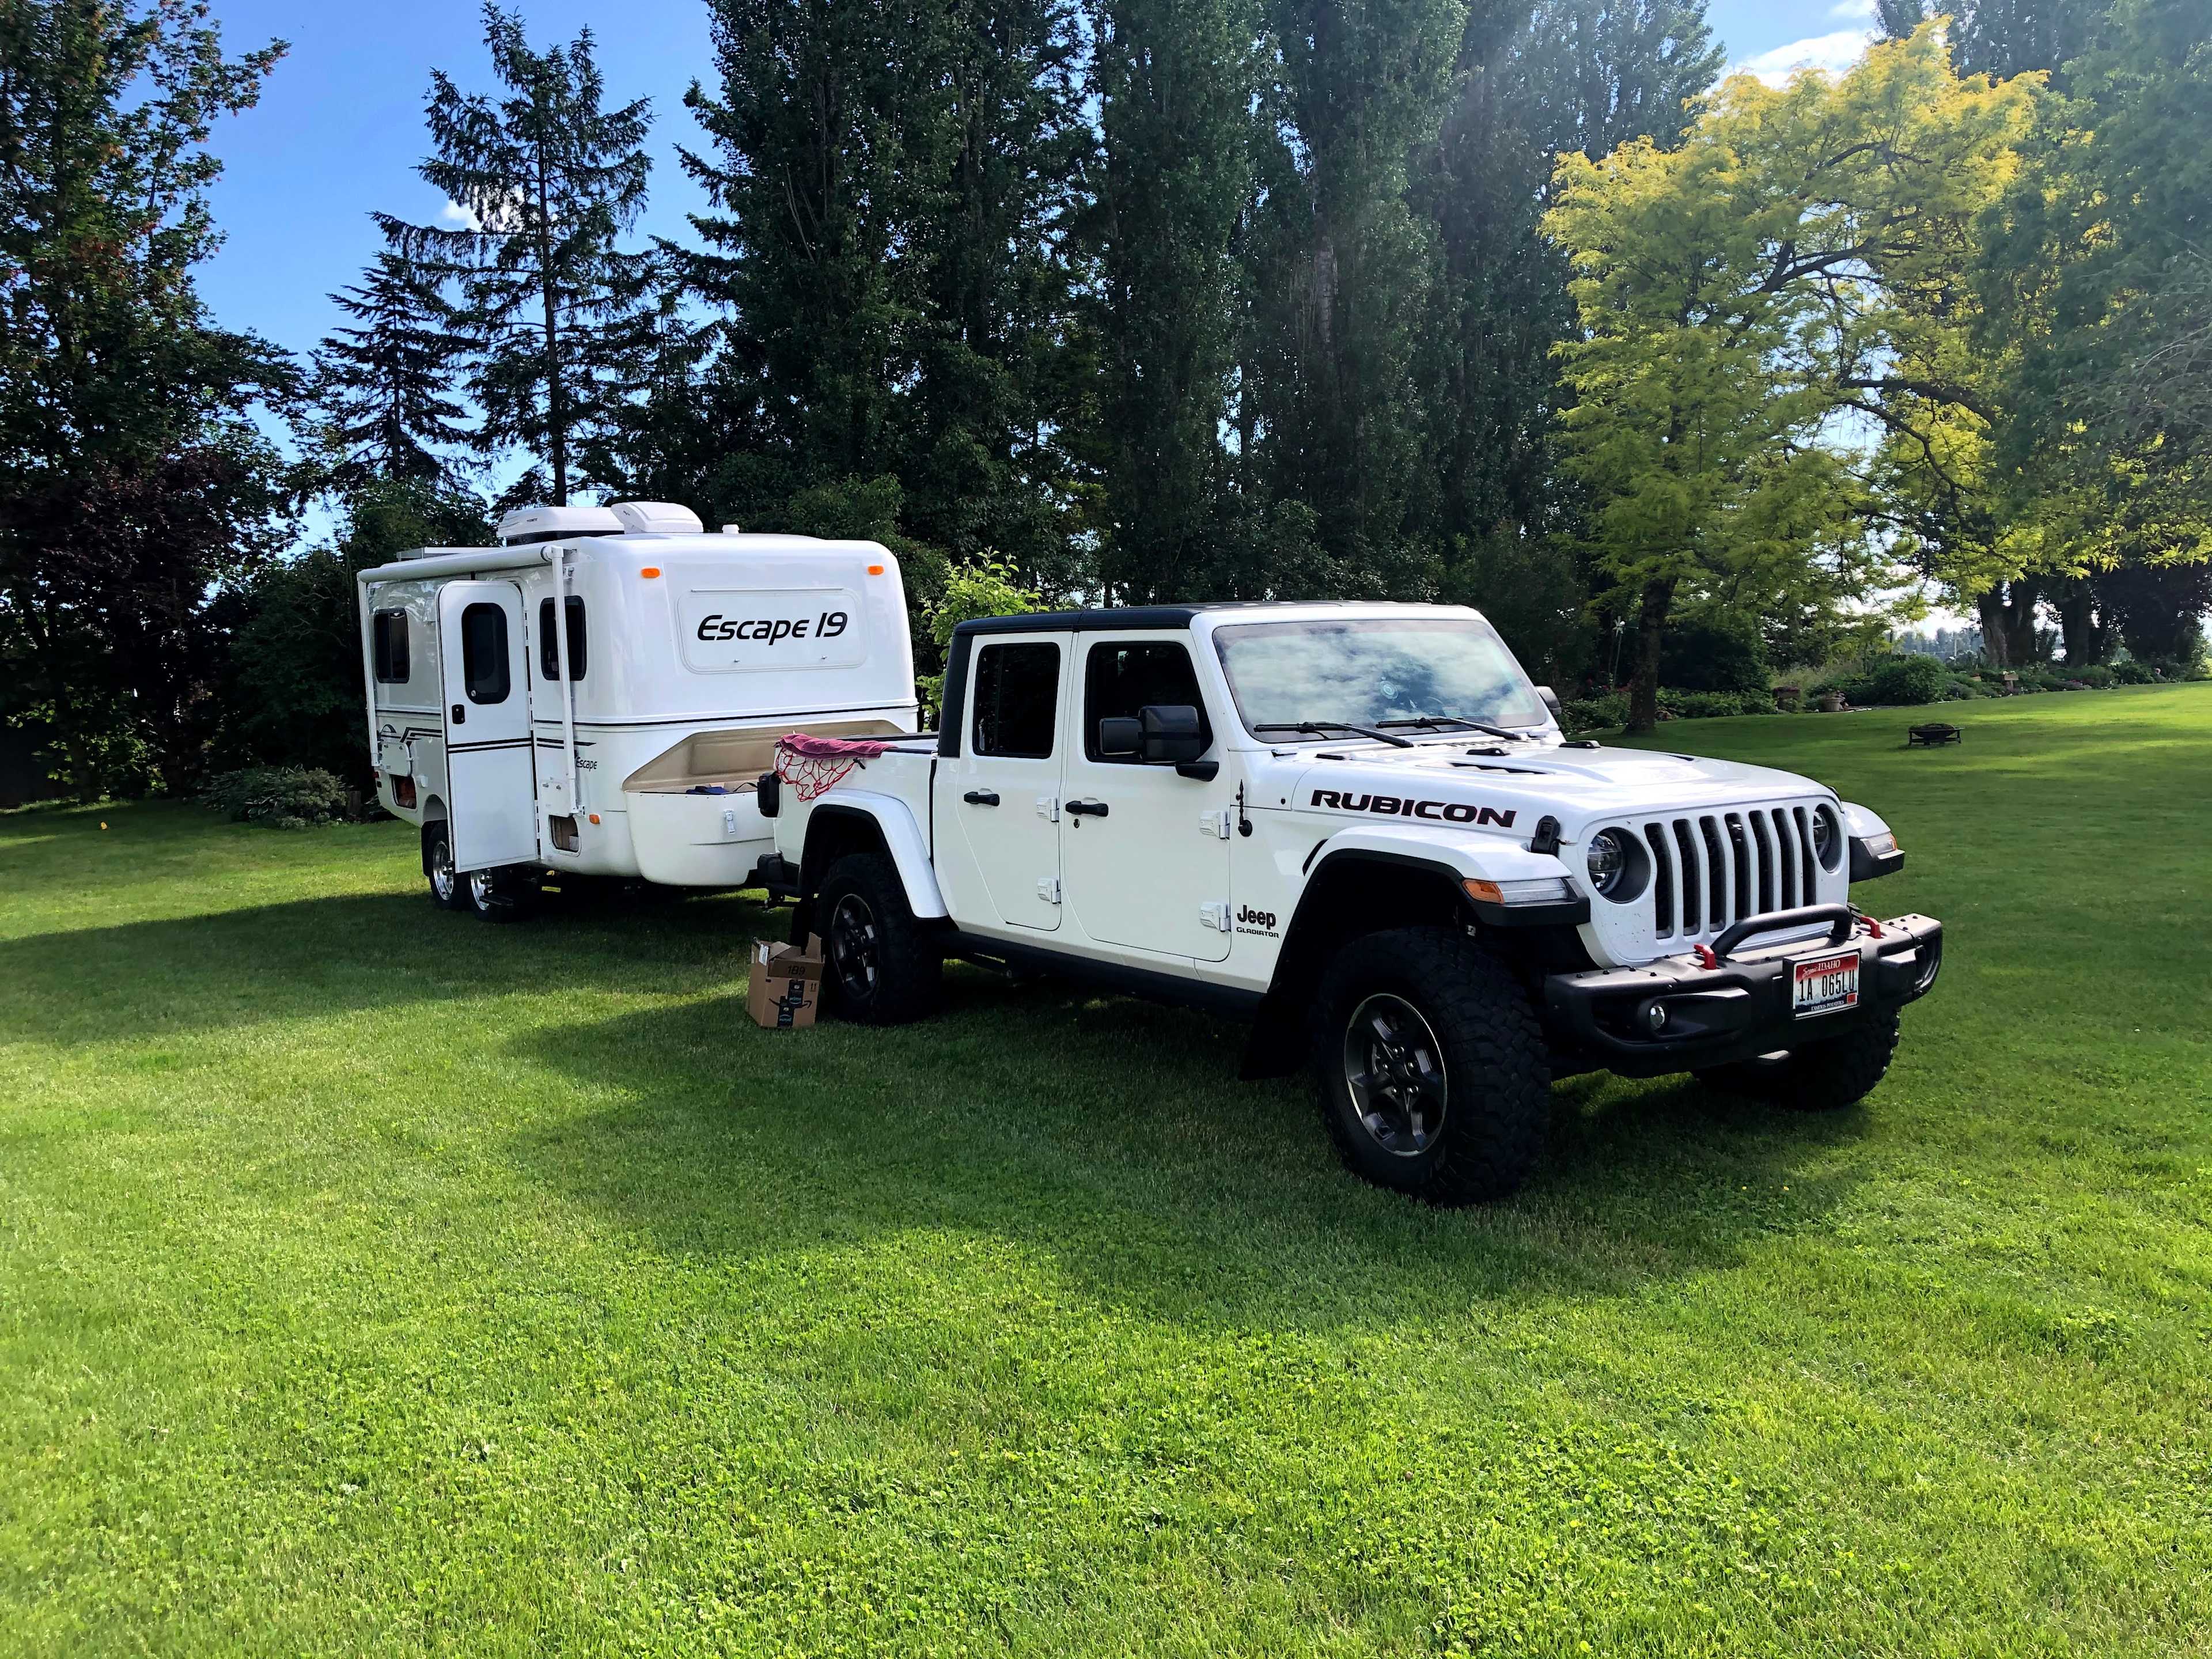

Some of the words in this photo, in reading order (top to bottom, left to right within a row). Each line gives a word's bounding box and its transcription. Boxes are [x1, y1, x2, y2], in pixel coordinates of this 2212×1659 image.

[698, 615, 810, 645] Escape
[816, 612, 848, 638] 19
[576, 756, 597, 772] Escape
[1310, 790, 1517, 828] RUBICON
[1237, 904, 1276, 930] Jeep
[1236, 927, 1279, 938] GLADIATOR
[1818, 960, 1840, 971] IDAHO
[1800, 978, 1813, 1002] 1A
[1821, 969, 1854, 997] 065LU
